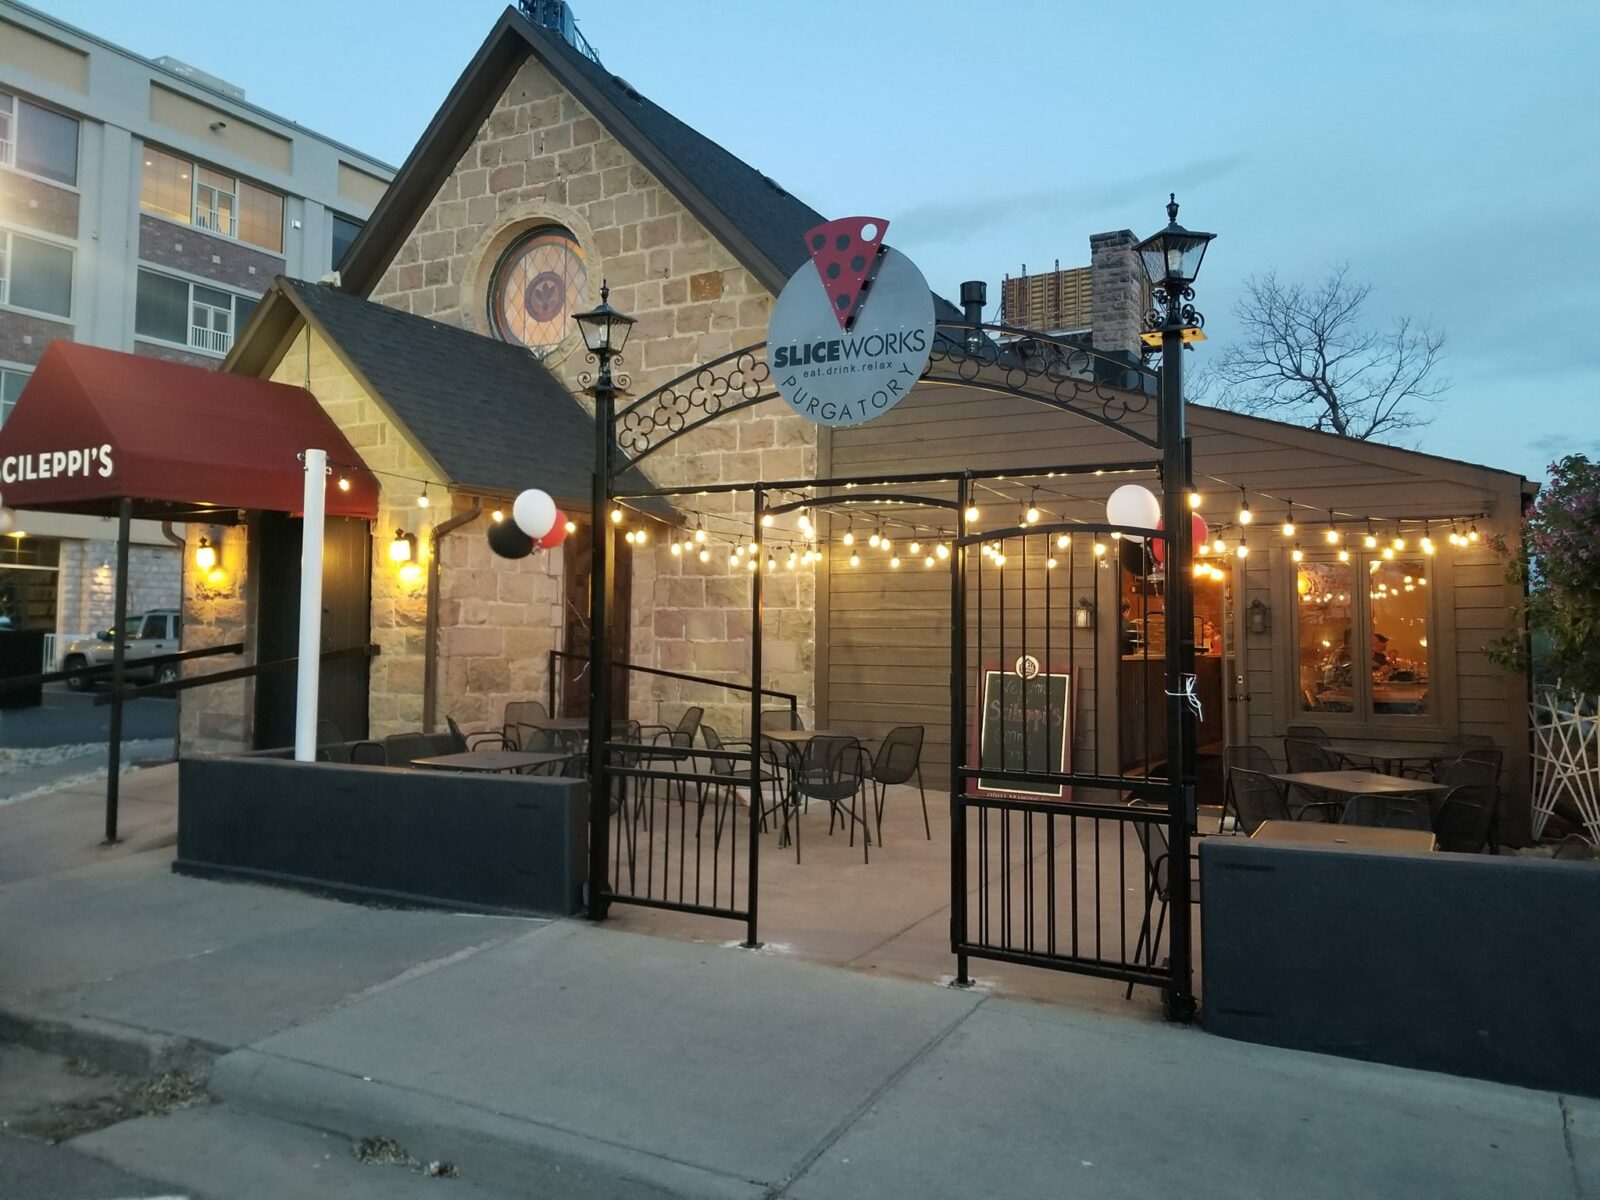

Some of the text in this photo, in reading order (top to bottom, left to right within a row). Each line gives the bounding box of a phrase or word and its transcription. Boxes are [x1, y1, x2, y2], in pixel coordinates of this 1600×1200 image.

[774, 329, 926, 368] SLICEWORKS
[803, 361, 893, 378] eat.drink.relax
[781, 362, 915, 420] PURGATORY
[0, 444, 113, 484] CILEPPI'S
